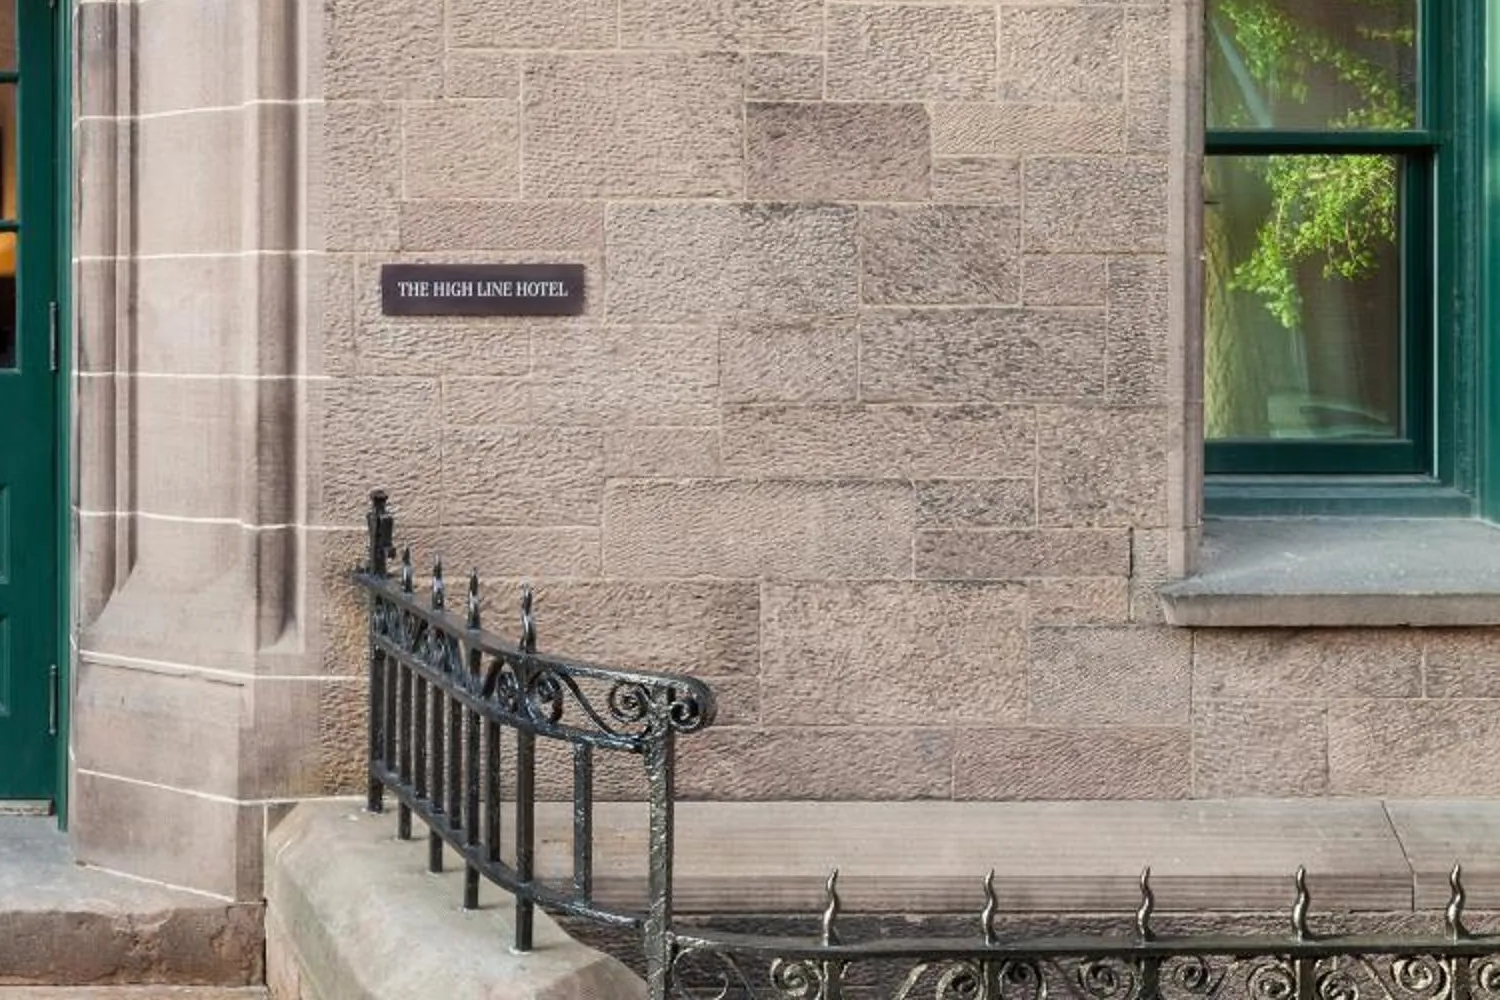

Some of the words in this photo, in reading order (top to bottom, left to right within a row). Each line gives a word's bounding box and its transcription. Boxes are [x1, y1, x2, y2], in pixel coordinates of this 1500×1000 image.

[397, 281, 430, 297] THE
[433, 281, 473, 297] HIGH
[477, 281, 513, 297] LINE
[516, 281, 569, 297] HOTEL
